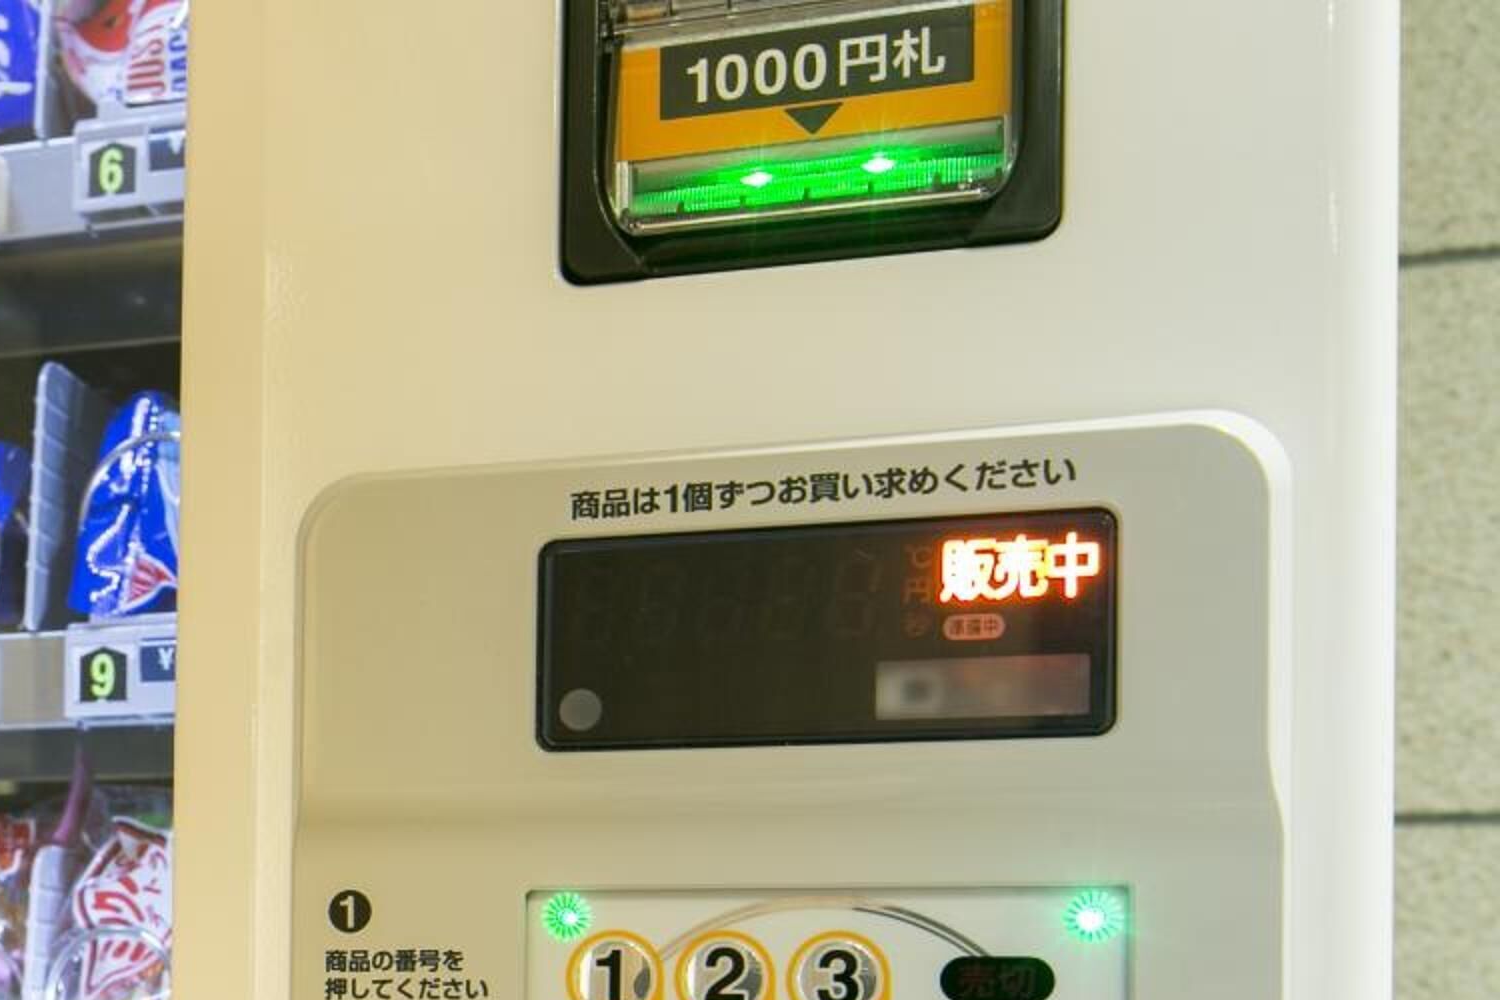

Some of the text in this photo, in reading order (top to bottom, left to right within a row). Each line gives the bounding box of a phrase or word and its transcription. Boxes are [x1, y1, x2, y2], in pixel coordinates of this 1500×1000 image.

[686, 28, 947, 103] 1000円札
[99, 147, 124, 193] 6
[571, 457, 1077, 520] 商品は1個ずつお買い求めください
[939, 531, 1100, 603] 販売中
[90, 653, 116, 697] 9
[325, 950, 464, 973] 商品の番号を
[325, 977, 489, 1000] 押してください
